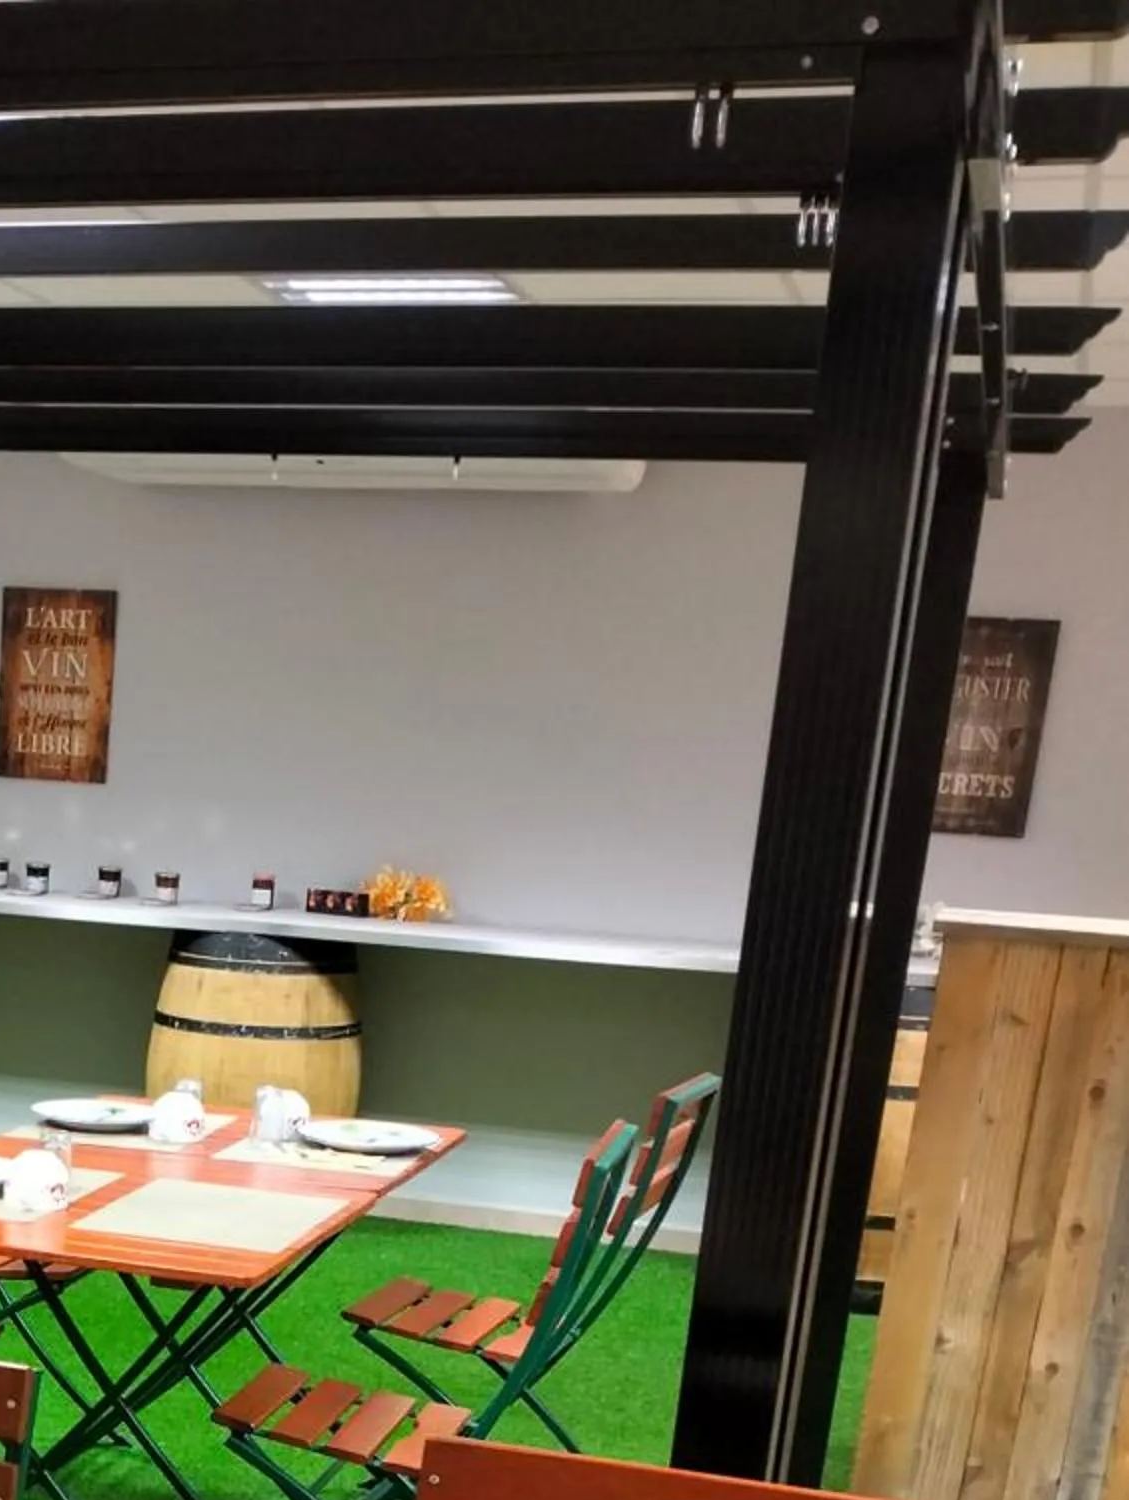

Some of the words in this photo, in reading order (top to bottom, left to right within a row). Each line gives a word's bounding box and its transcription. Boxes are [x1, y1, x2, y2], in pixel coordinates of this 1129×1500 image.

[25, 606, 93, 629] L'ART
[22, 647, 88, 679] VIN
[16, 734, 88, 757] LIBRE
